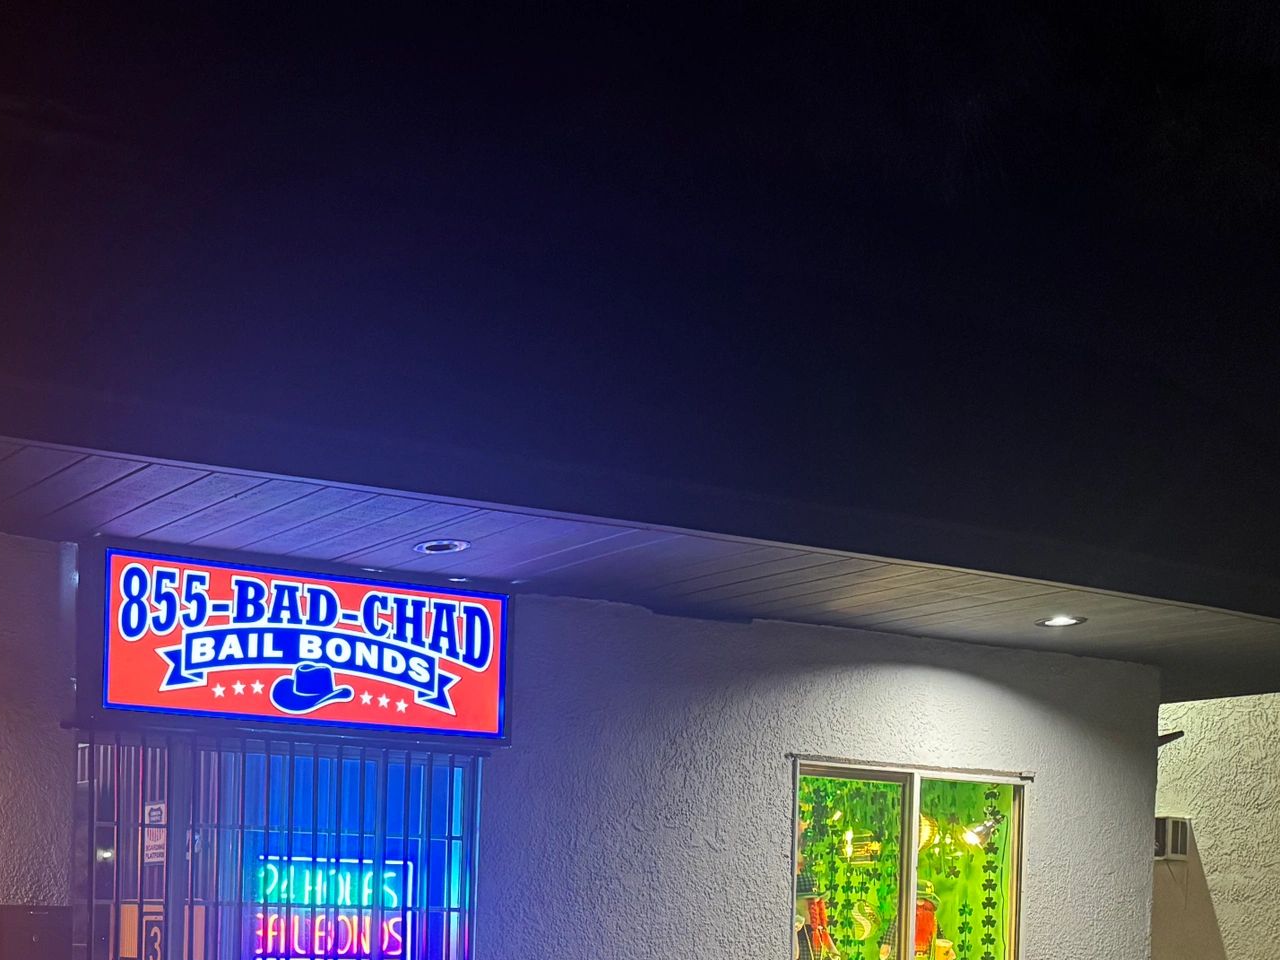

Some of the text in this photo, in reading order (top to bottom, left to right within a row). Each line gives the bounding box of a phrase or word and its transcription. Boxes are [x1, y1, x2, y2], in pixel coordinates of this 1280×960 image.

[119, 564, 493, 672] 855-BAD-CHAD
[190, 632, 431, 684] BAIL BONDS
